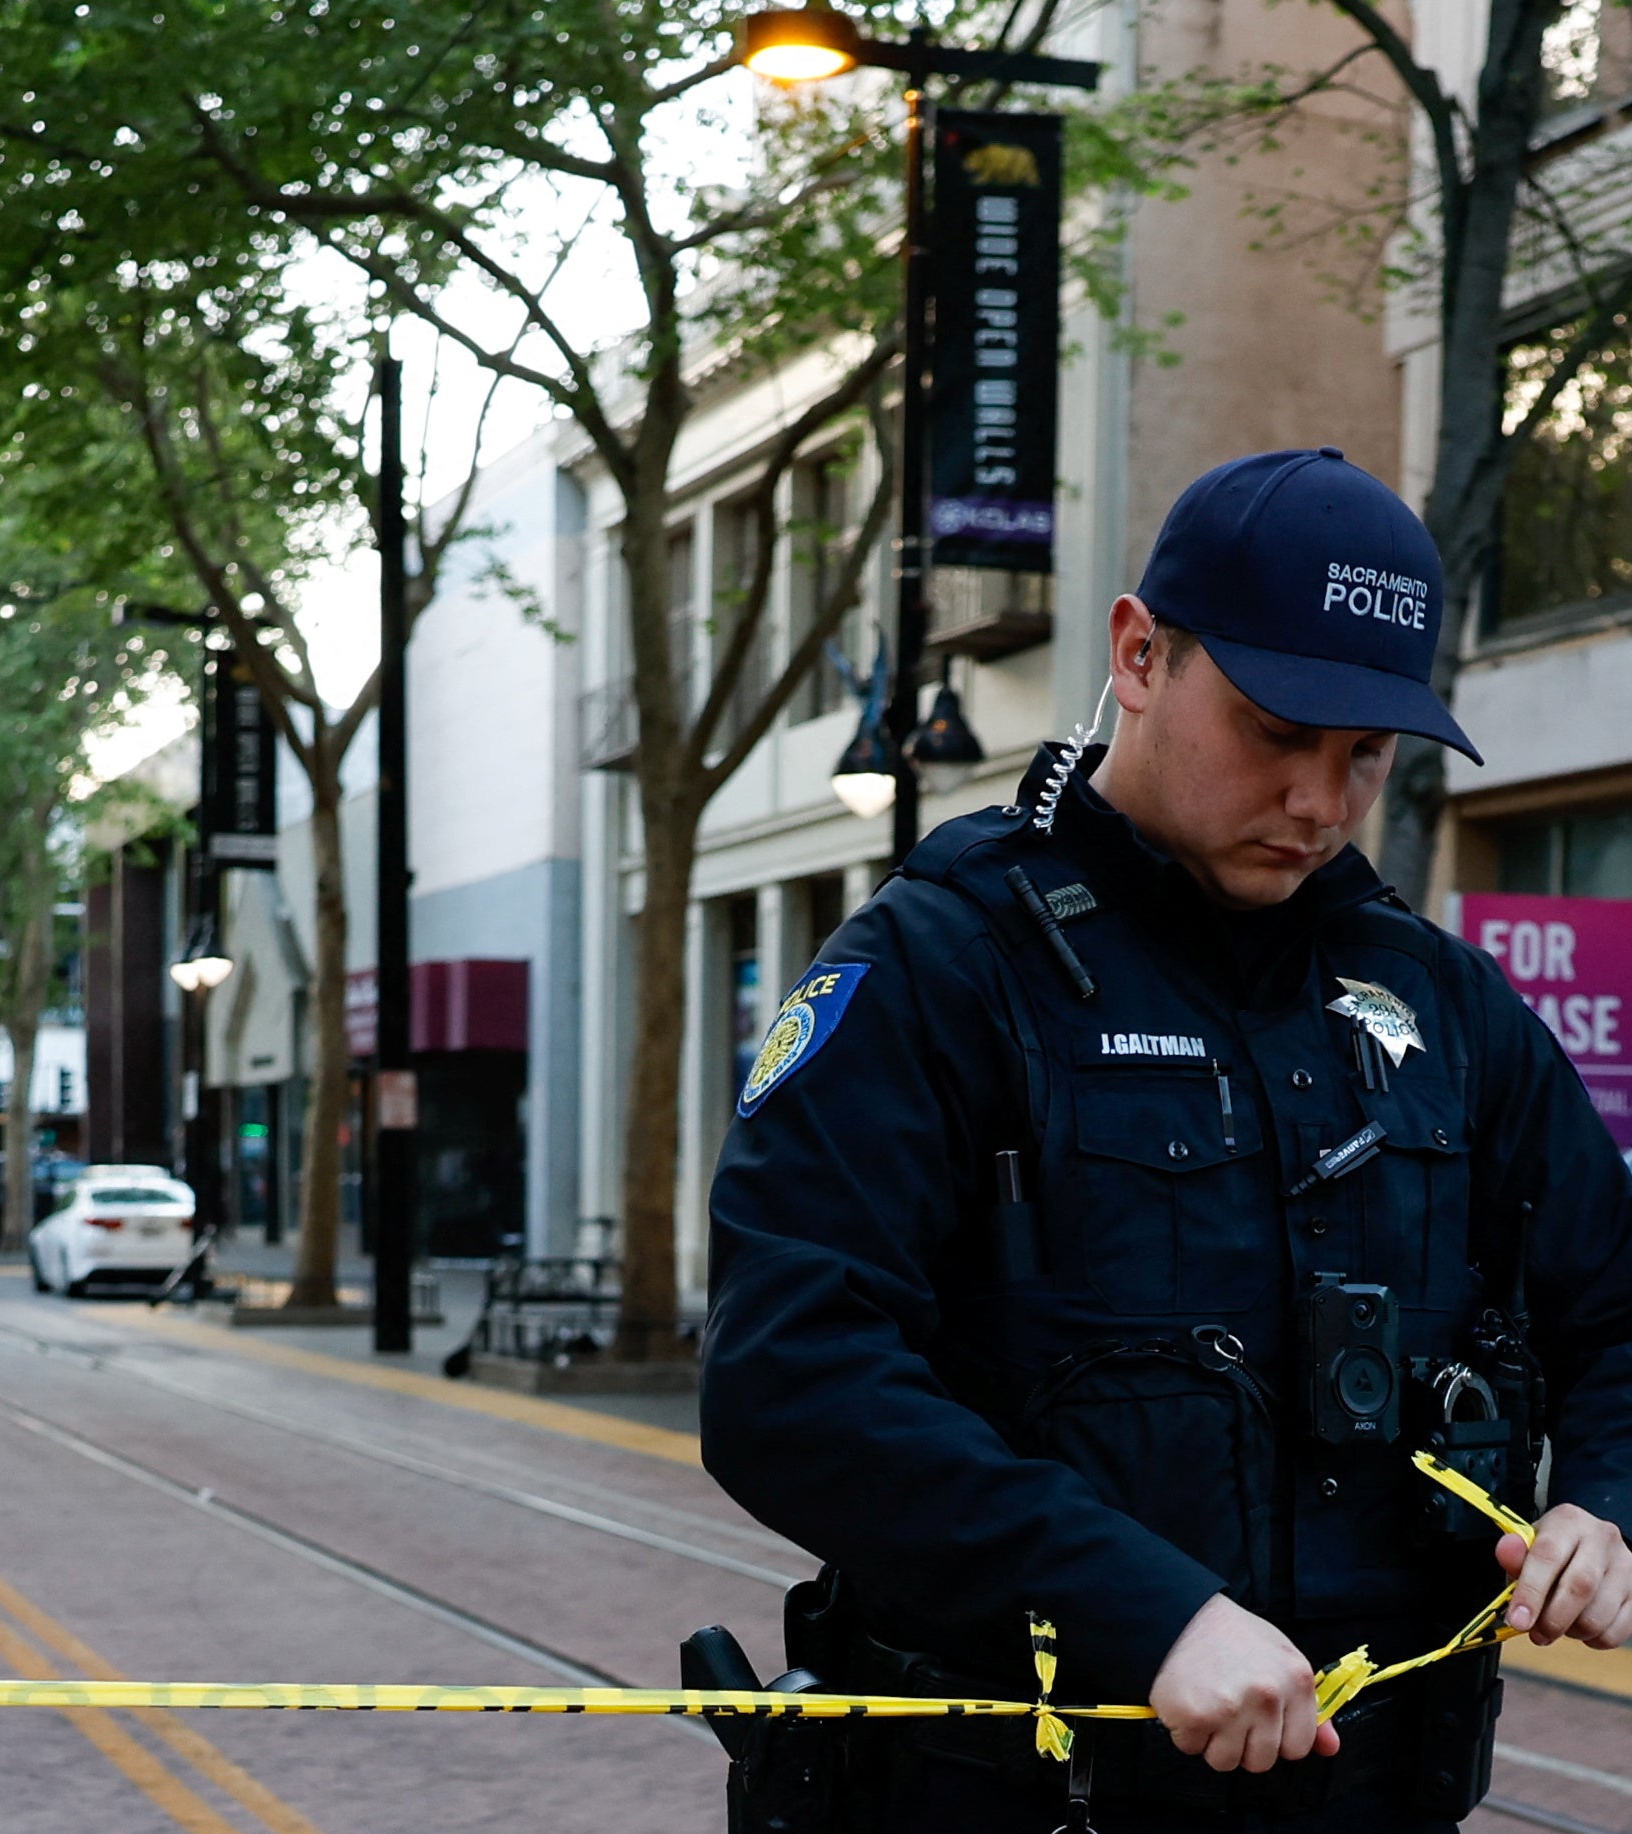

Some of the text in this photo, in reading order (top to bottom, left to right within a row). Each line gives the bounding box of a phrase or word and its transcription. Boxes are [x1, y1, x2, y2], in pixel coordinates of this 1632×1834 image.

[974, 195, 1018, 487] WIDE OPEN WALLS
[1327, 562, 1428, 599] SACRAMENTO
[1323, 581, 1427, 630] POLICE
[1480, 919, 1577, 983] FOR
[780, 972, 842, 1014] POLICE
[1101, 1033, 1206, 1057] J.GALTMAN
[1521, 993, 1622, 1056] ASE
[1354, 1421, 1377, 1431] AXON
